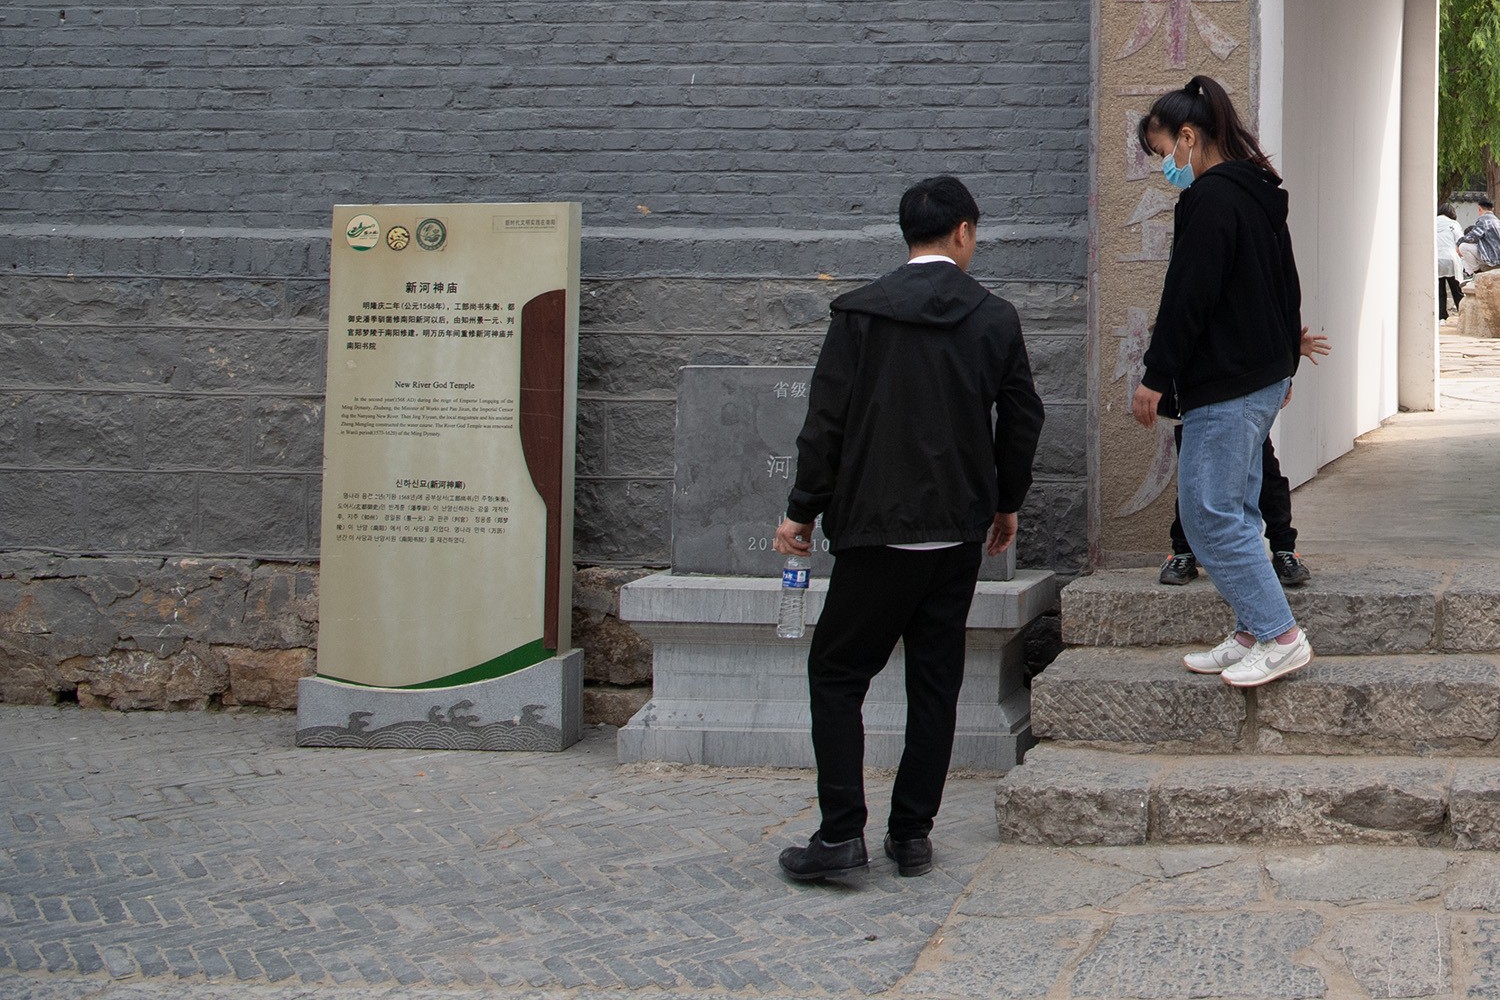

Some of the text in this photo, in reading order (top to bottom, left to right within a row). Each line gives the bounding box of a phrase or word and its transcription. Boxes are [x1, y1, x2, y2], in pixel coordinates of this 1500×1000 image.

[405, 281, 458, 294] 新河神庙
[412, 381, 431, 389] River
[432, 381, 448, 389] God
[449, 381, 475, 390] Temple
[767, 454, 792, 480] 河
